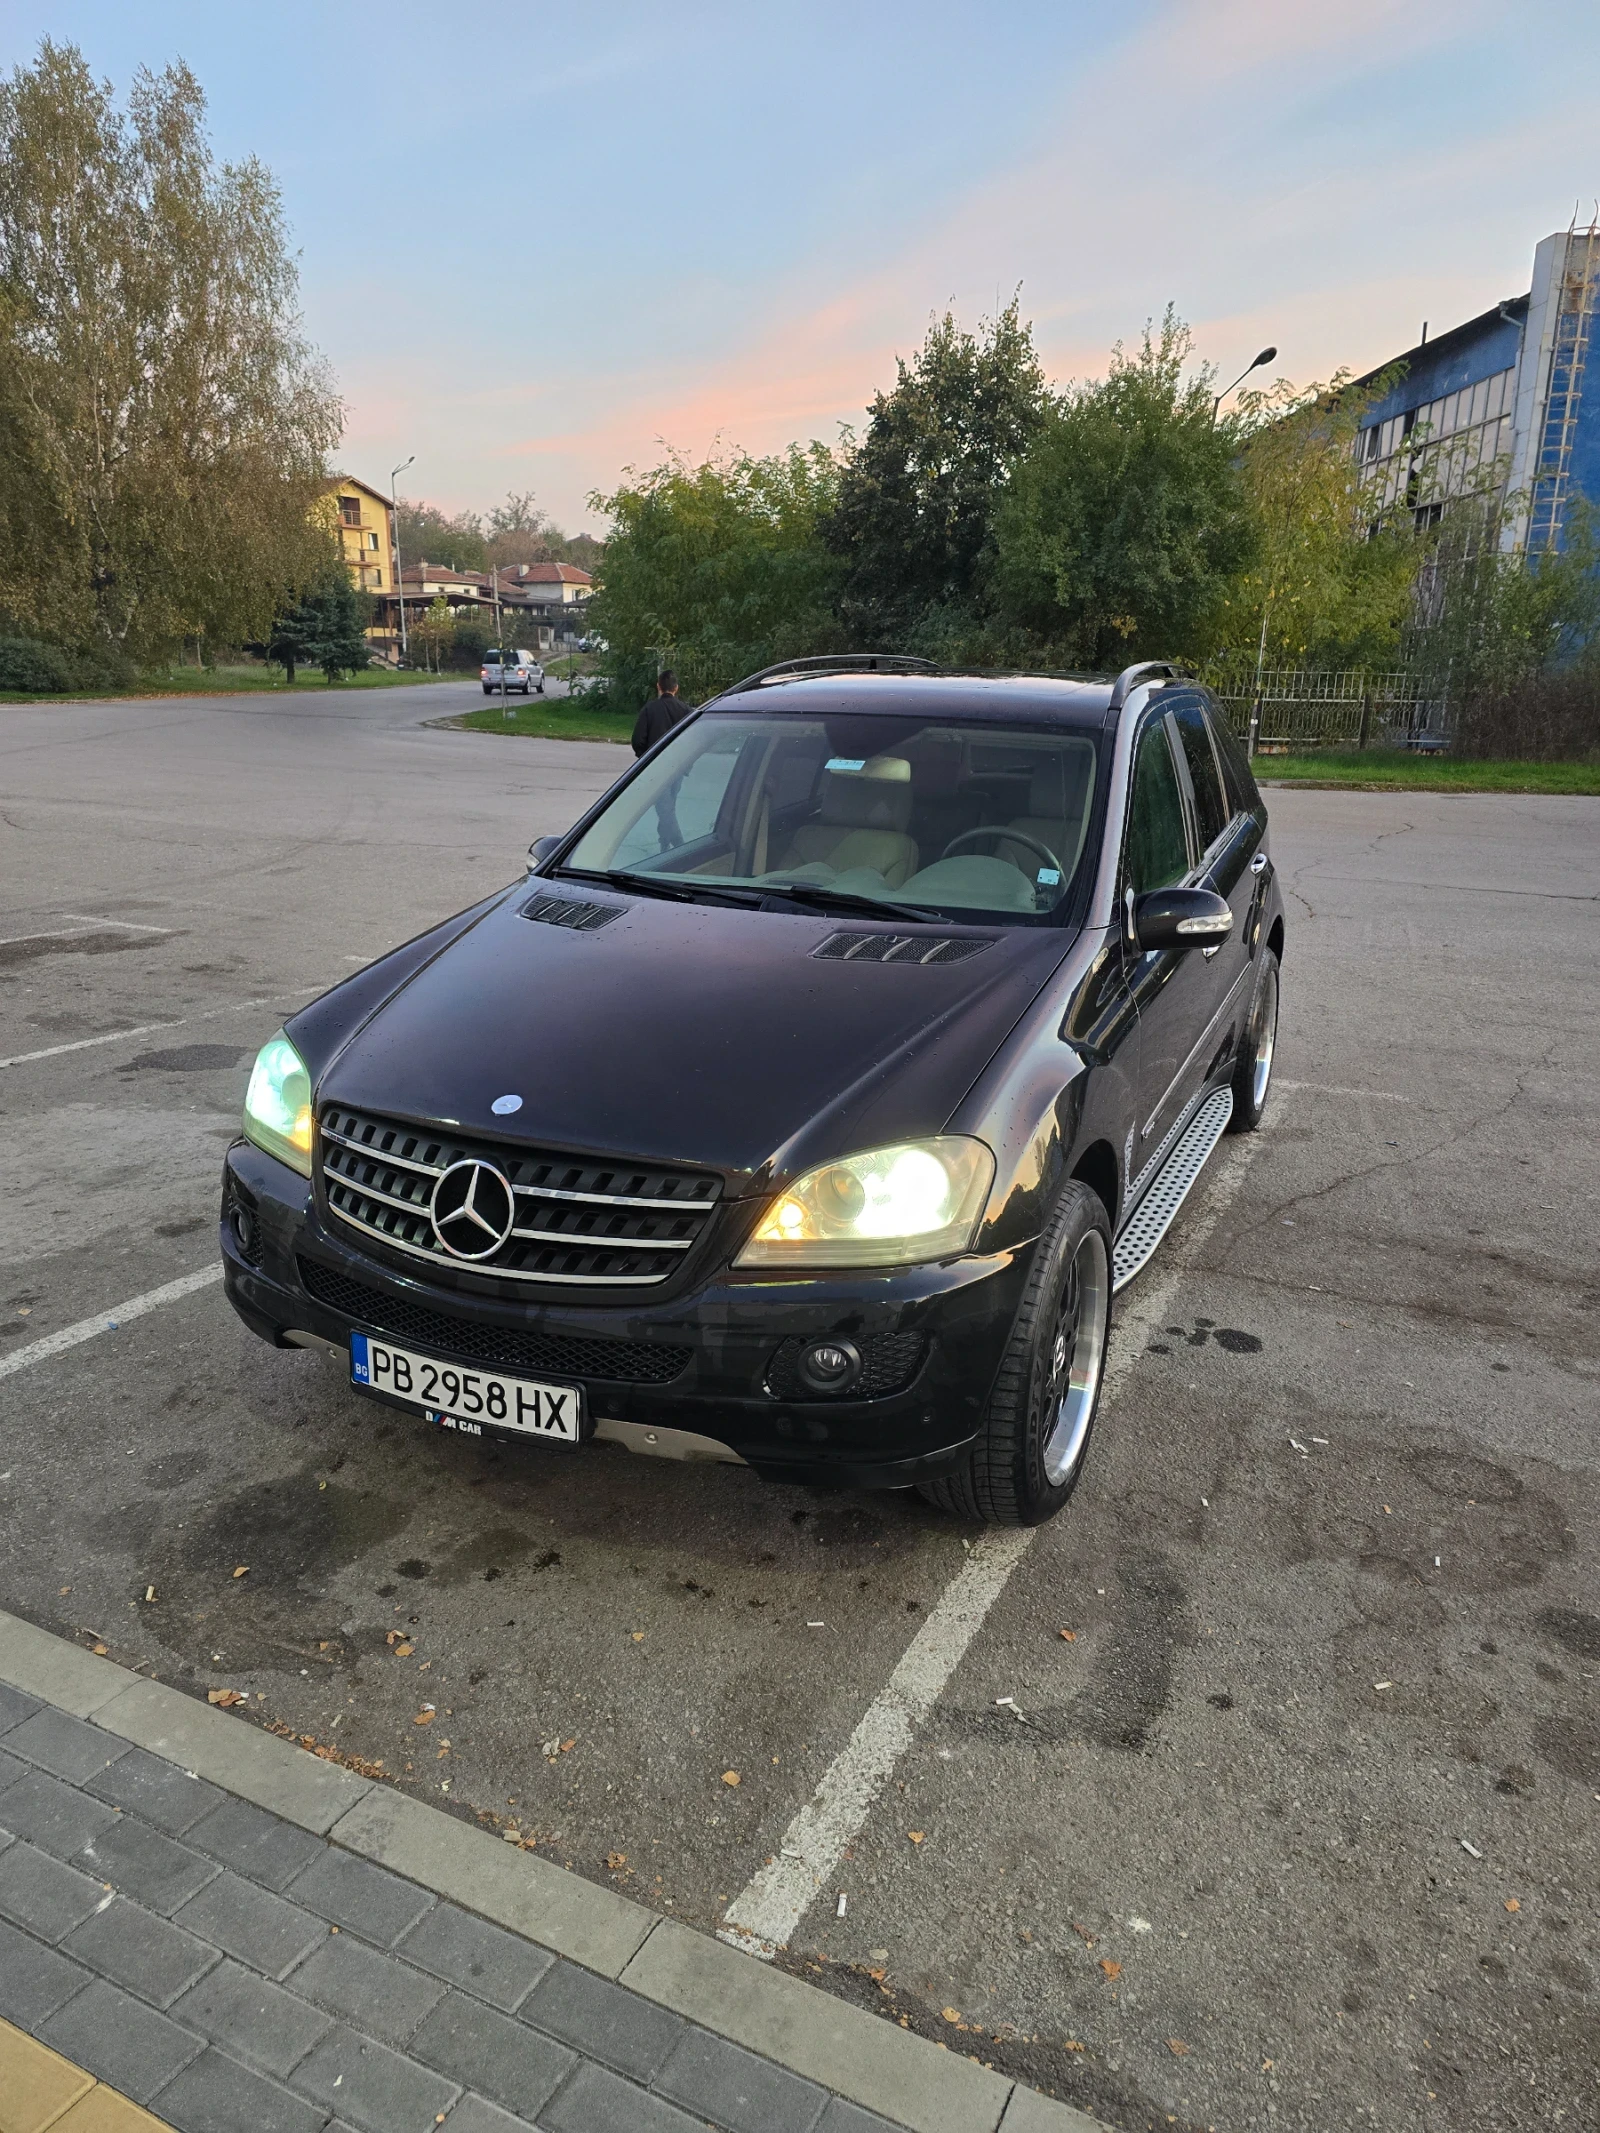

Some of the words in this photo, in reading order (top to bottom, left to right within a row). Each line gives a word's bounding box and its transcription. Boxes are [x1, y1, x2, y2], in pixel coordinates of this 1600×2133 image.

[355, 1362, 368, 1378] BG
[372, 1346, 413, 1393] PB
[420, 1364, 507, 1419] 2958
[516, 1386, 568, 1433] HX
[459, 1420, 482, 1436] CAR
